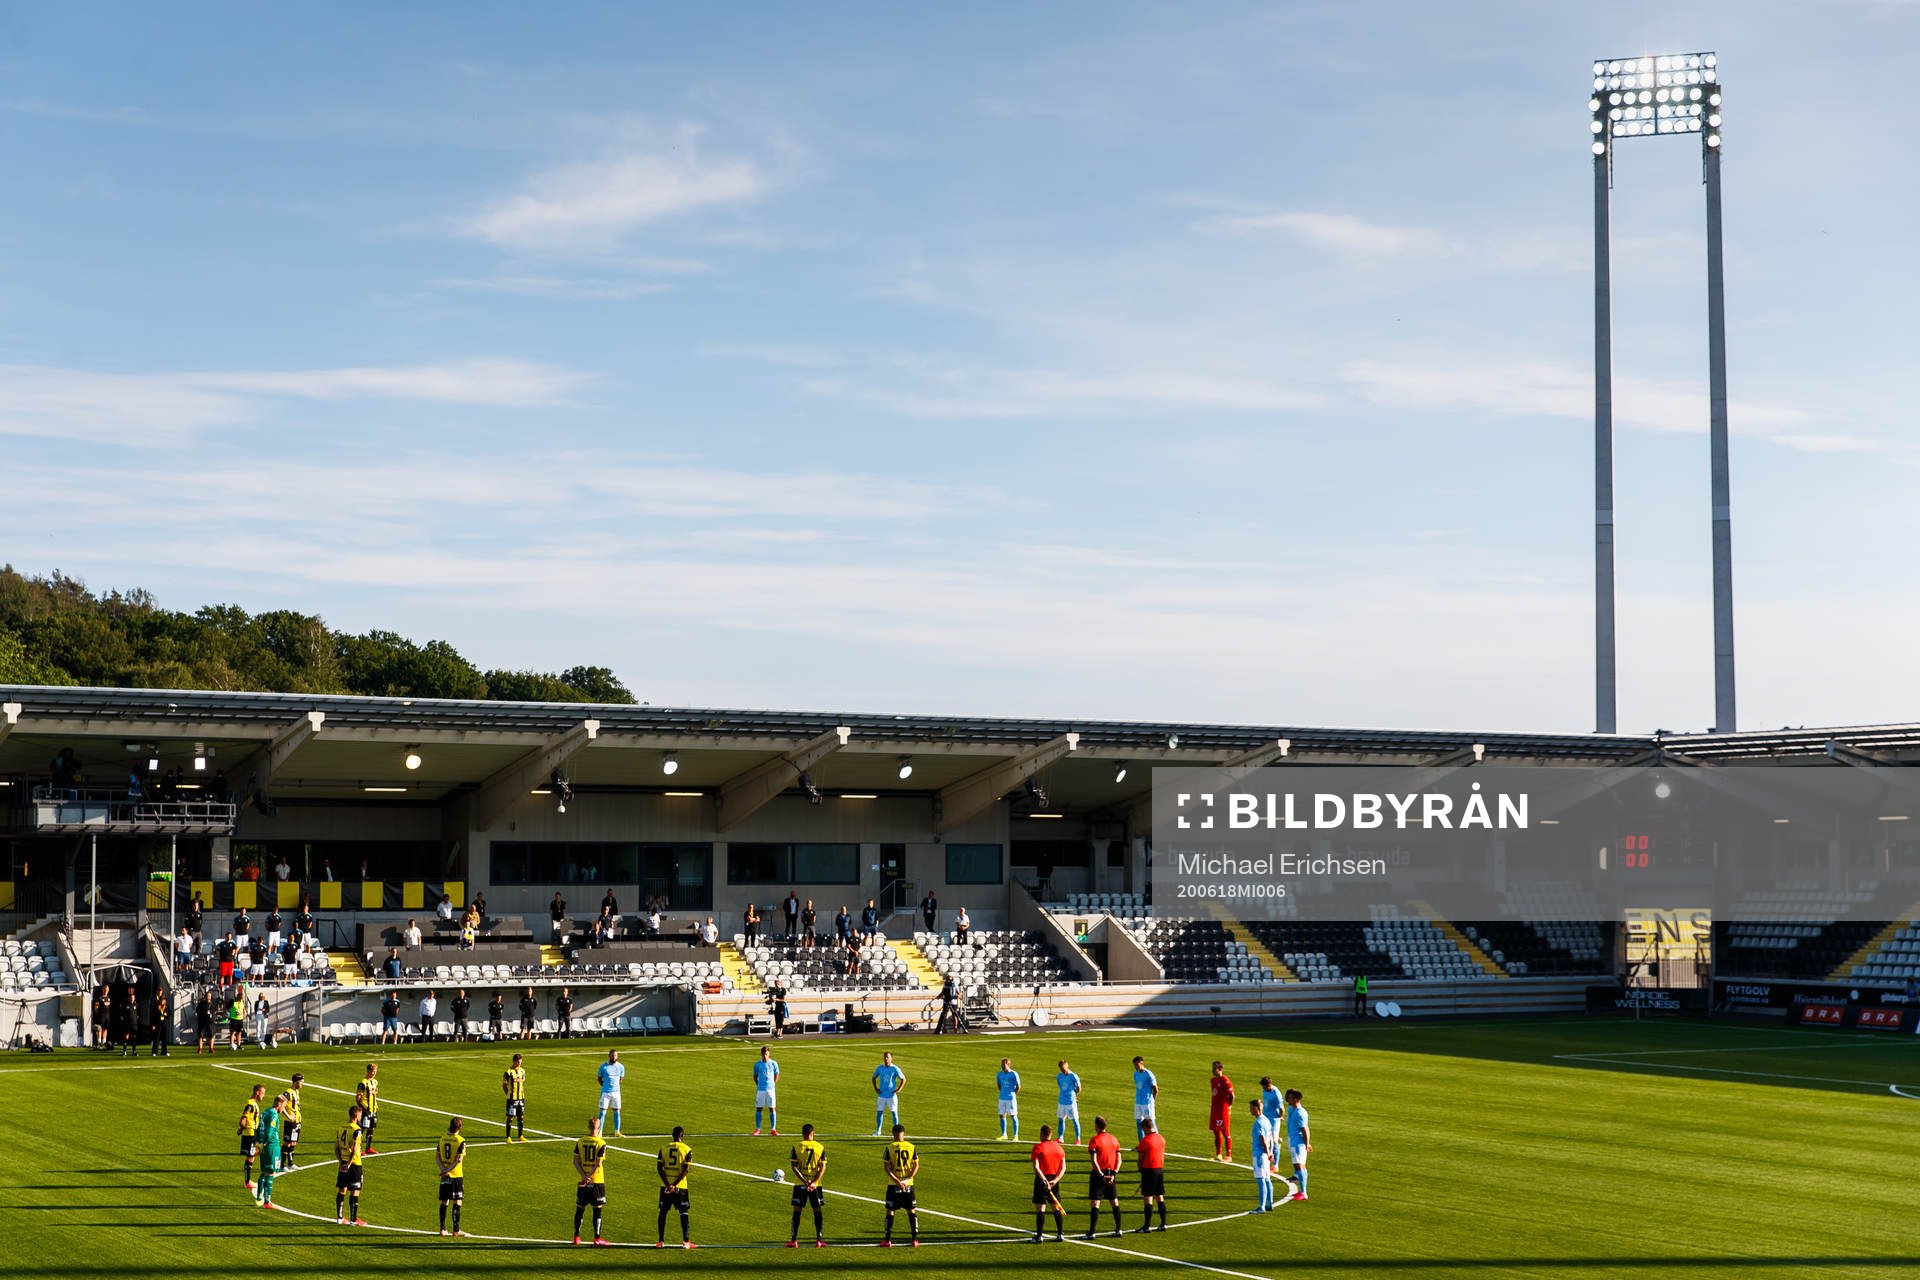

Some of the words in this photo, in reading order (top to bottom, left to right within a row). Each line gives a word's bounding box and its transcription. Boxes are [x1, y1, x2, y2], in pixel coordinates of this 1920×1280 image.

[1615, 999, 1681, 1009] WELLNESS
[1624, 990, 1670, 1000] NORDIC
[1804, 1008, 1841, 1019] BRA
[1861, 1012, 1898, 1022] BRA
[340, 1129, 347, 1147] 4
[444, 1142, 451, 1160] 8
[583, 1144, 596, 1162] 10
[668, 1148, 678, 1166] 5
[806, 1148, 815, 1166] 7
